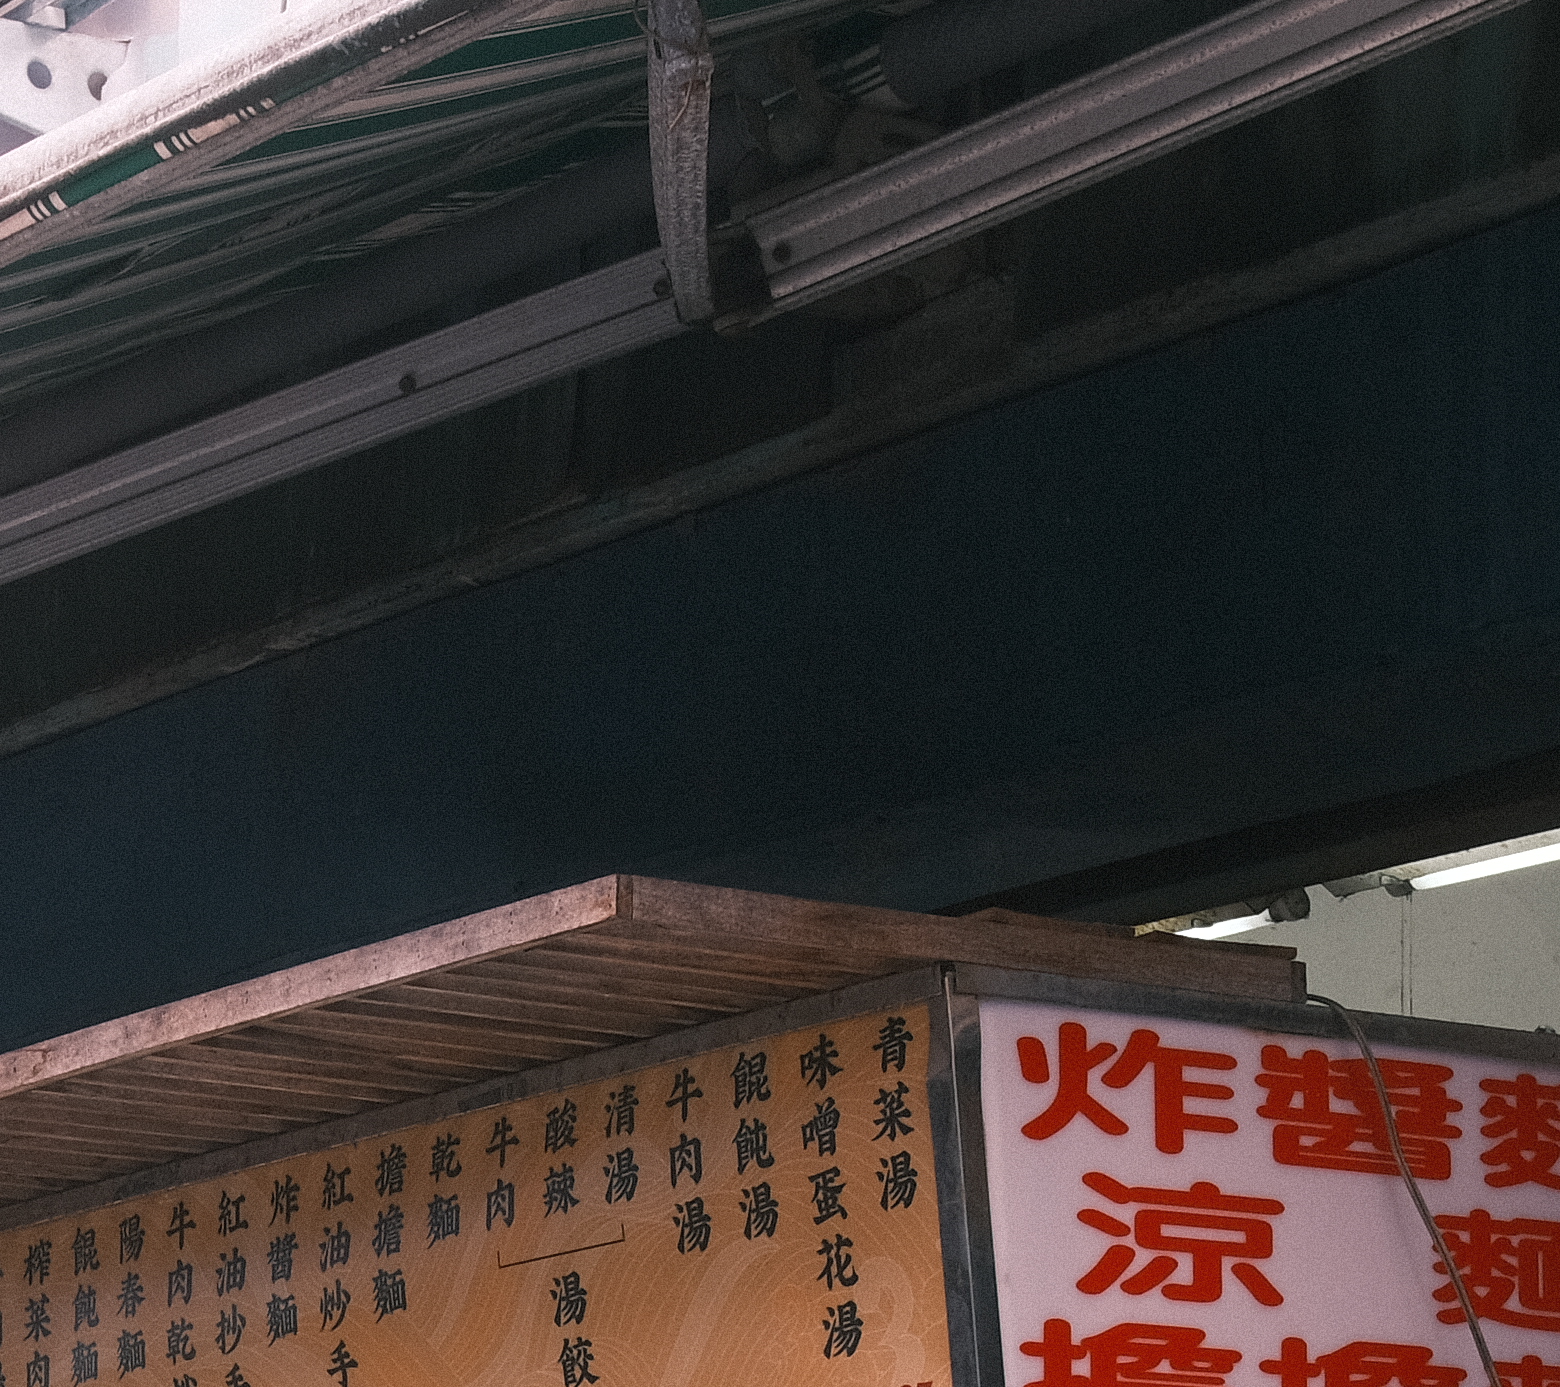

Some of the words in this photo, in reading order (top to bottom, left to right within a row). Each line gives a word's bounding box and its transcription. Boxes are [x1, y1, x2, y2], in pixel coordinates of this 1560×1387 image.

[426, 1133, 462, 1249] 乾麵
[485, 1115, 519, 1231] 牛肉
[541, 1097, 579, 1217] 酸辣
[602, 1083, 640, 1204] 清湯
[664, 1068, 713, 1255] 牛肉湯
[729, 1052, 780, 1241] 餛飩湯
[799, 1033, 863, 1359] 味噌蛋花湯
[871, 1016, 918, 1213] 青菜湯
[117, 1213, 147, 1381] 陽春麵
[266, 1174, 300, 1347] 炸醬麵
[372, 1143, 408, 1323] 擔擔麵
